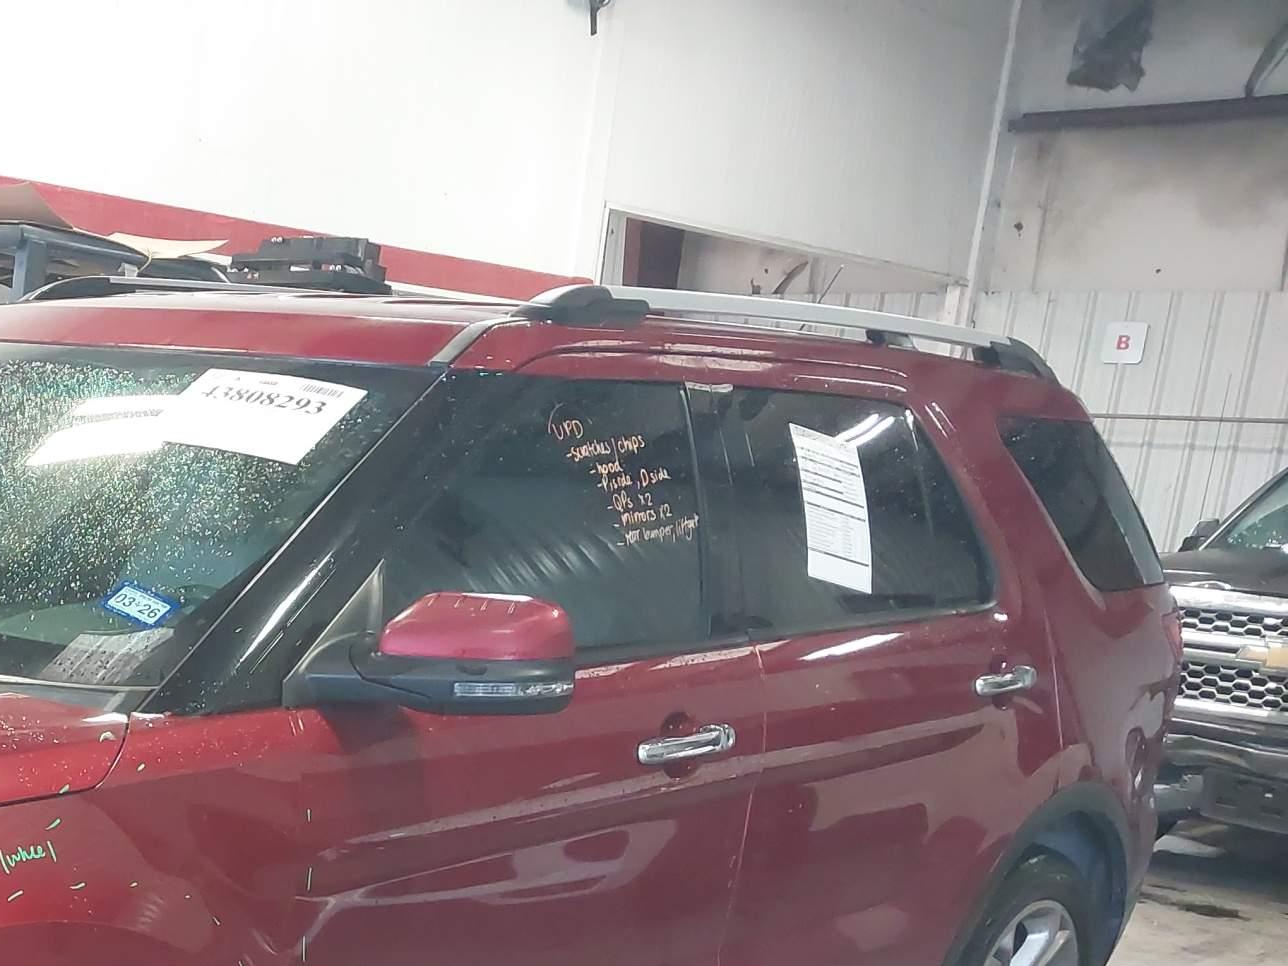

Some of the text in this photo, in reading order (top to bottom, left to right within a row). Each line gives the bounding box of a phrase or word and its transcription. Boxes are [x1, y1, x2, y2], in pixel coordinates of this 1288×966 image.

[1116, 335, 1130, 350] B
[114, 593, 136, 607] 03
[137, 603, 161, 619] 26
